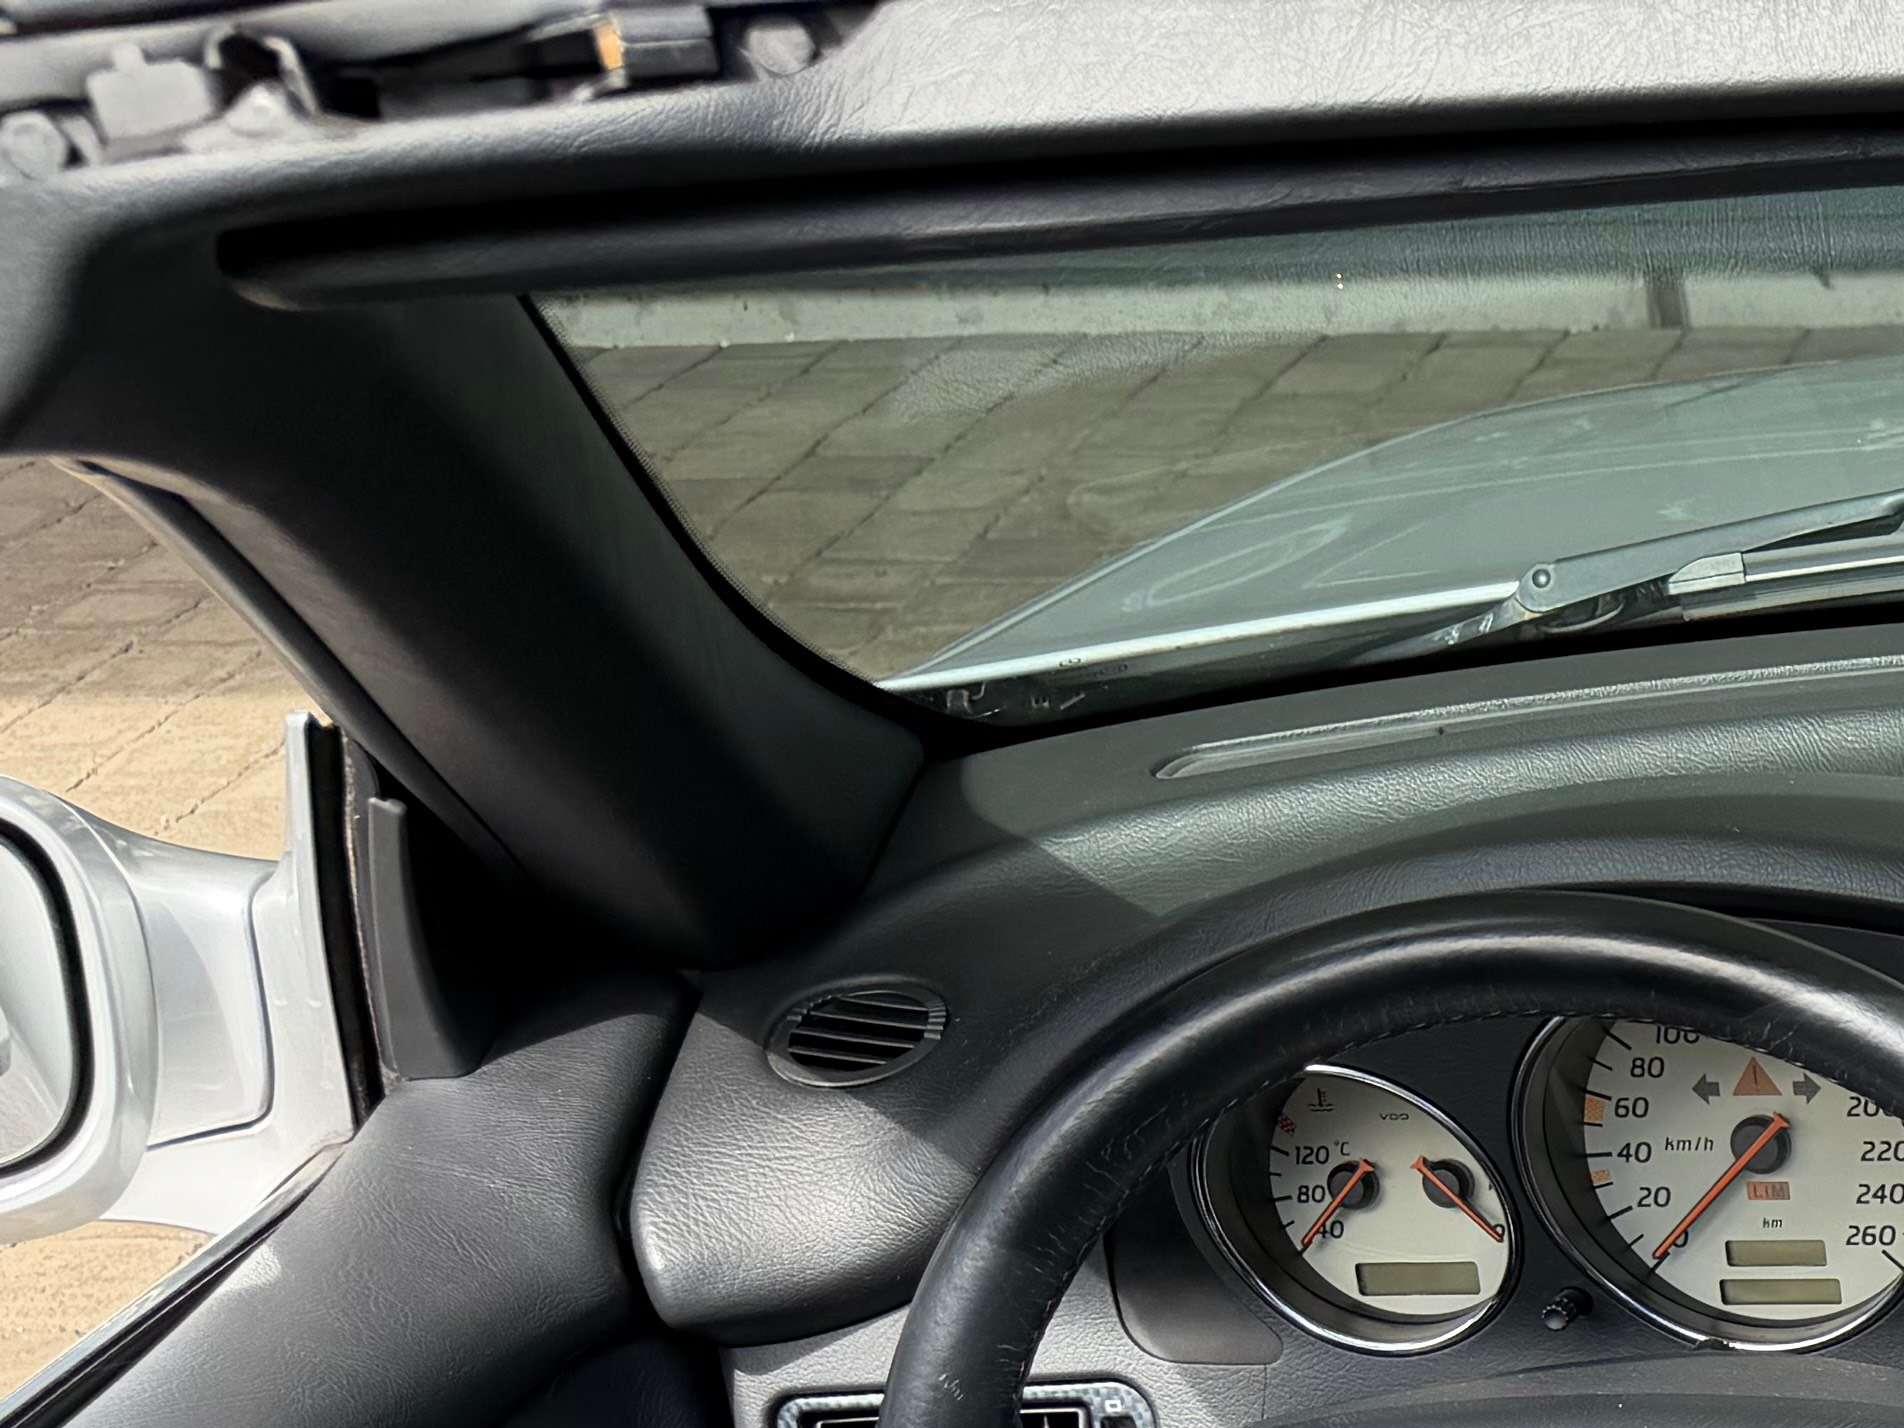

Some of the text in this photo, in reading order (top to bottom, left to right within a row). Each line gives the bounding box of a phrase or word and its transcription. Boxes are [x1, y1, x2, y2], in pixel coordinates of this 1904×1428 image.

[1630, 1056, 1665, 1078] 80
[1614, 1097, 1649, 1118] 60
[1847, 1096, 1894, 1117] 20
[1617, 1142, 1652, 1163] 40
[1664, 1136, 1714, 1151] km/h
[1295, 1145, 1330, 1165] 120
[1297, 1185, 1326, 1203] 80
[1637, 1186, 1671, 1207] 20
[1762, 1217, 1783, 1229] km
[1845, 1225, 1896, 1246] 260
